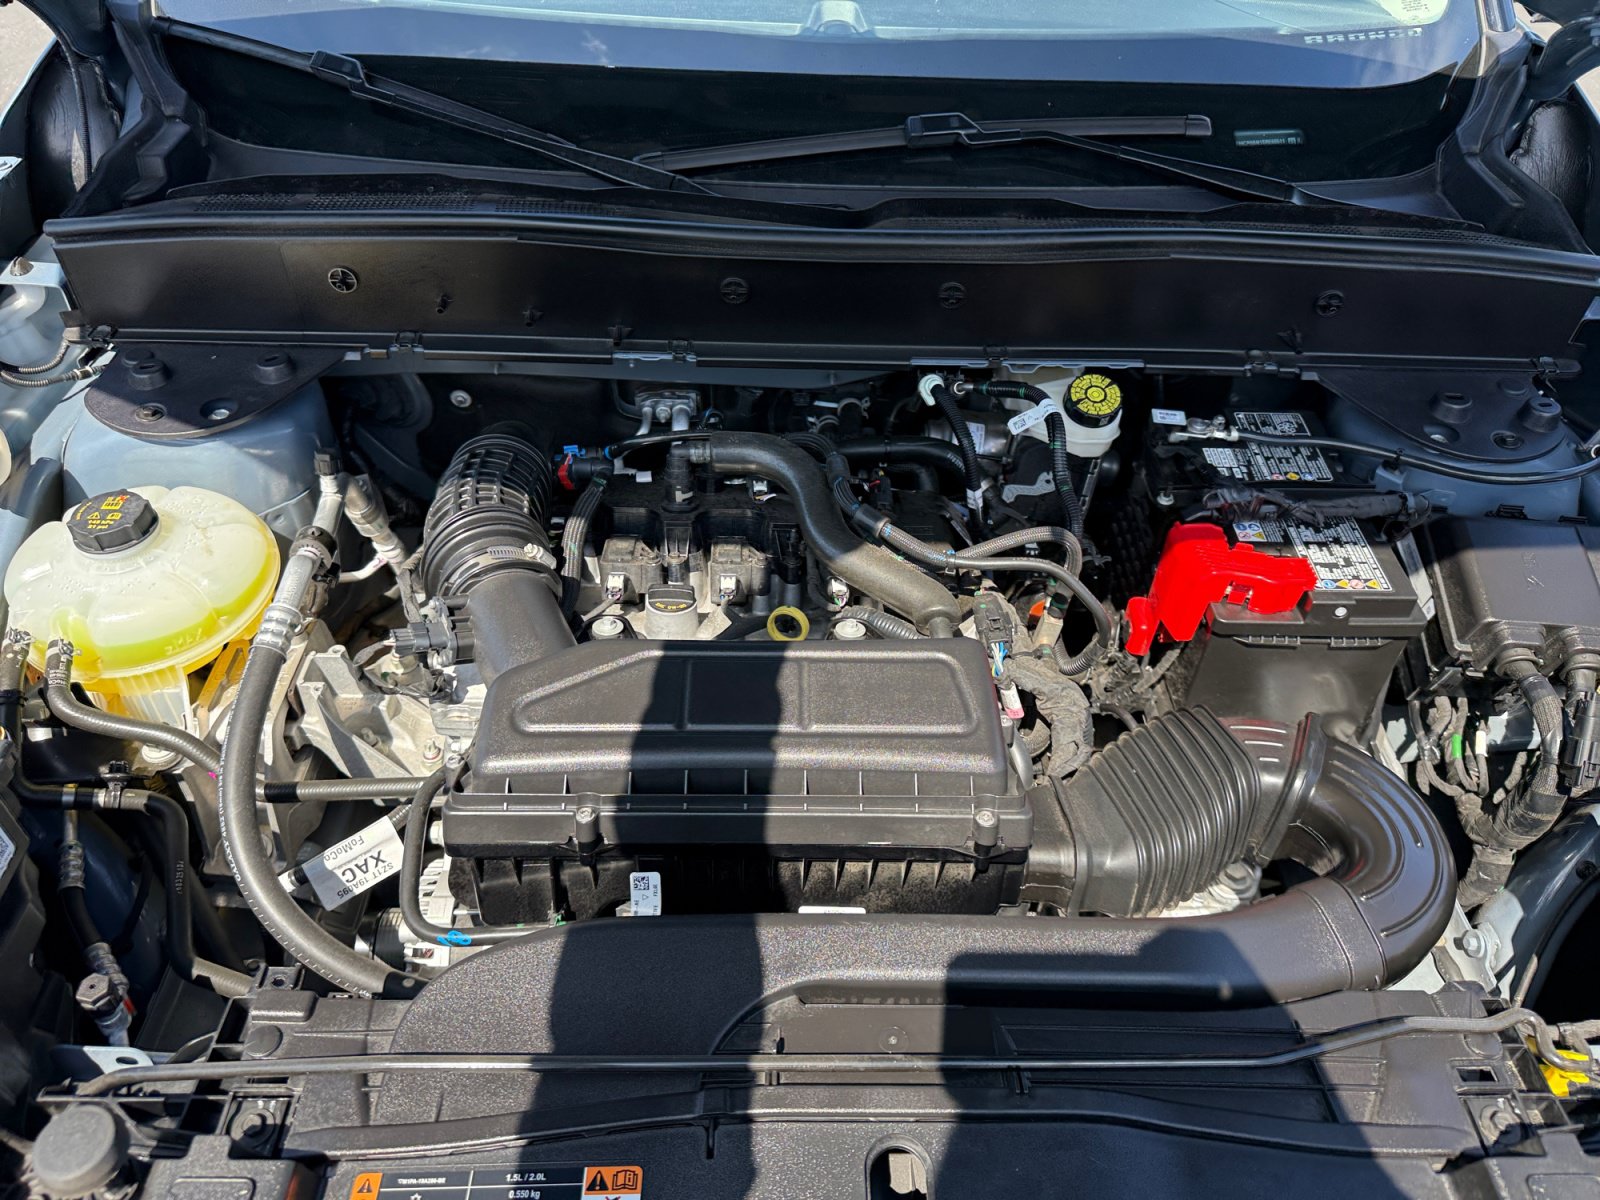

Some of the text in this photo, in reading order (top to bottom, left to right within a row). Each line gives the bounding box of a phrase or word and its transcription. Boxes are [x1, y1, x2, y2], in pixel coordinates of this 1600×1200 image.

[1303, 27, 1423, 44] BRONCO
[324, 834, 365, 862] FoMoCo
[223, 839, 242, 882] GALAXY
[341, 849, 387, 884] XAC
[505, 1173, 522, 1182] 1.5L
[529, 1172, 547, 1181] 2.0L
[508, 1189, 541, 1200] 0.550 kg
